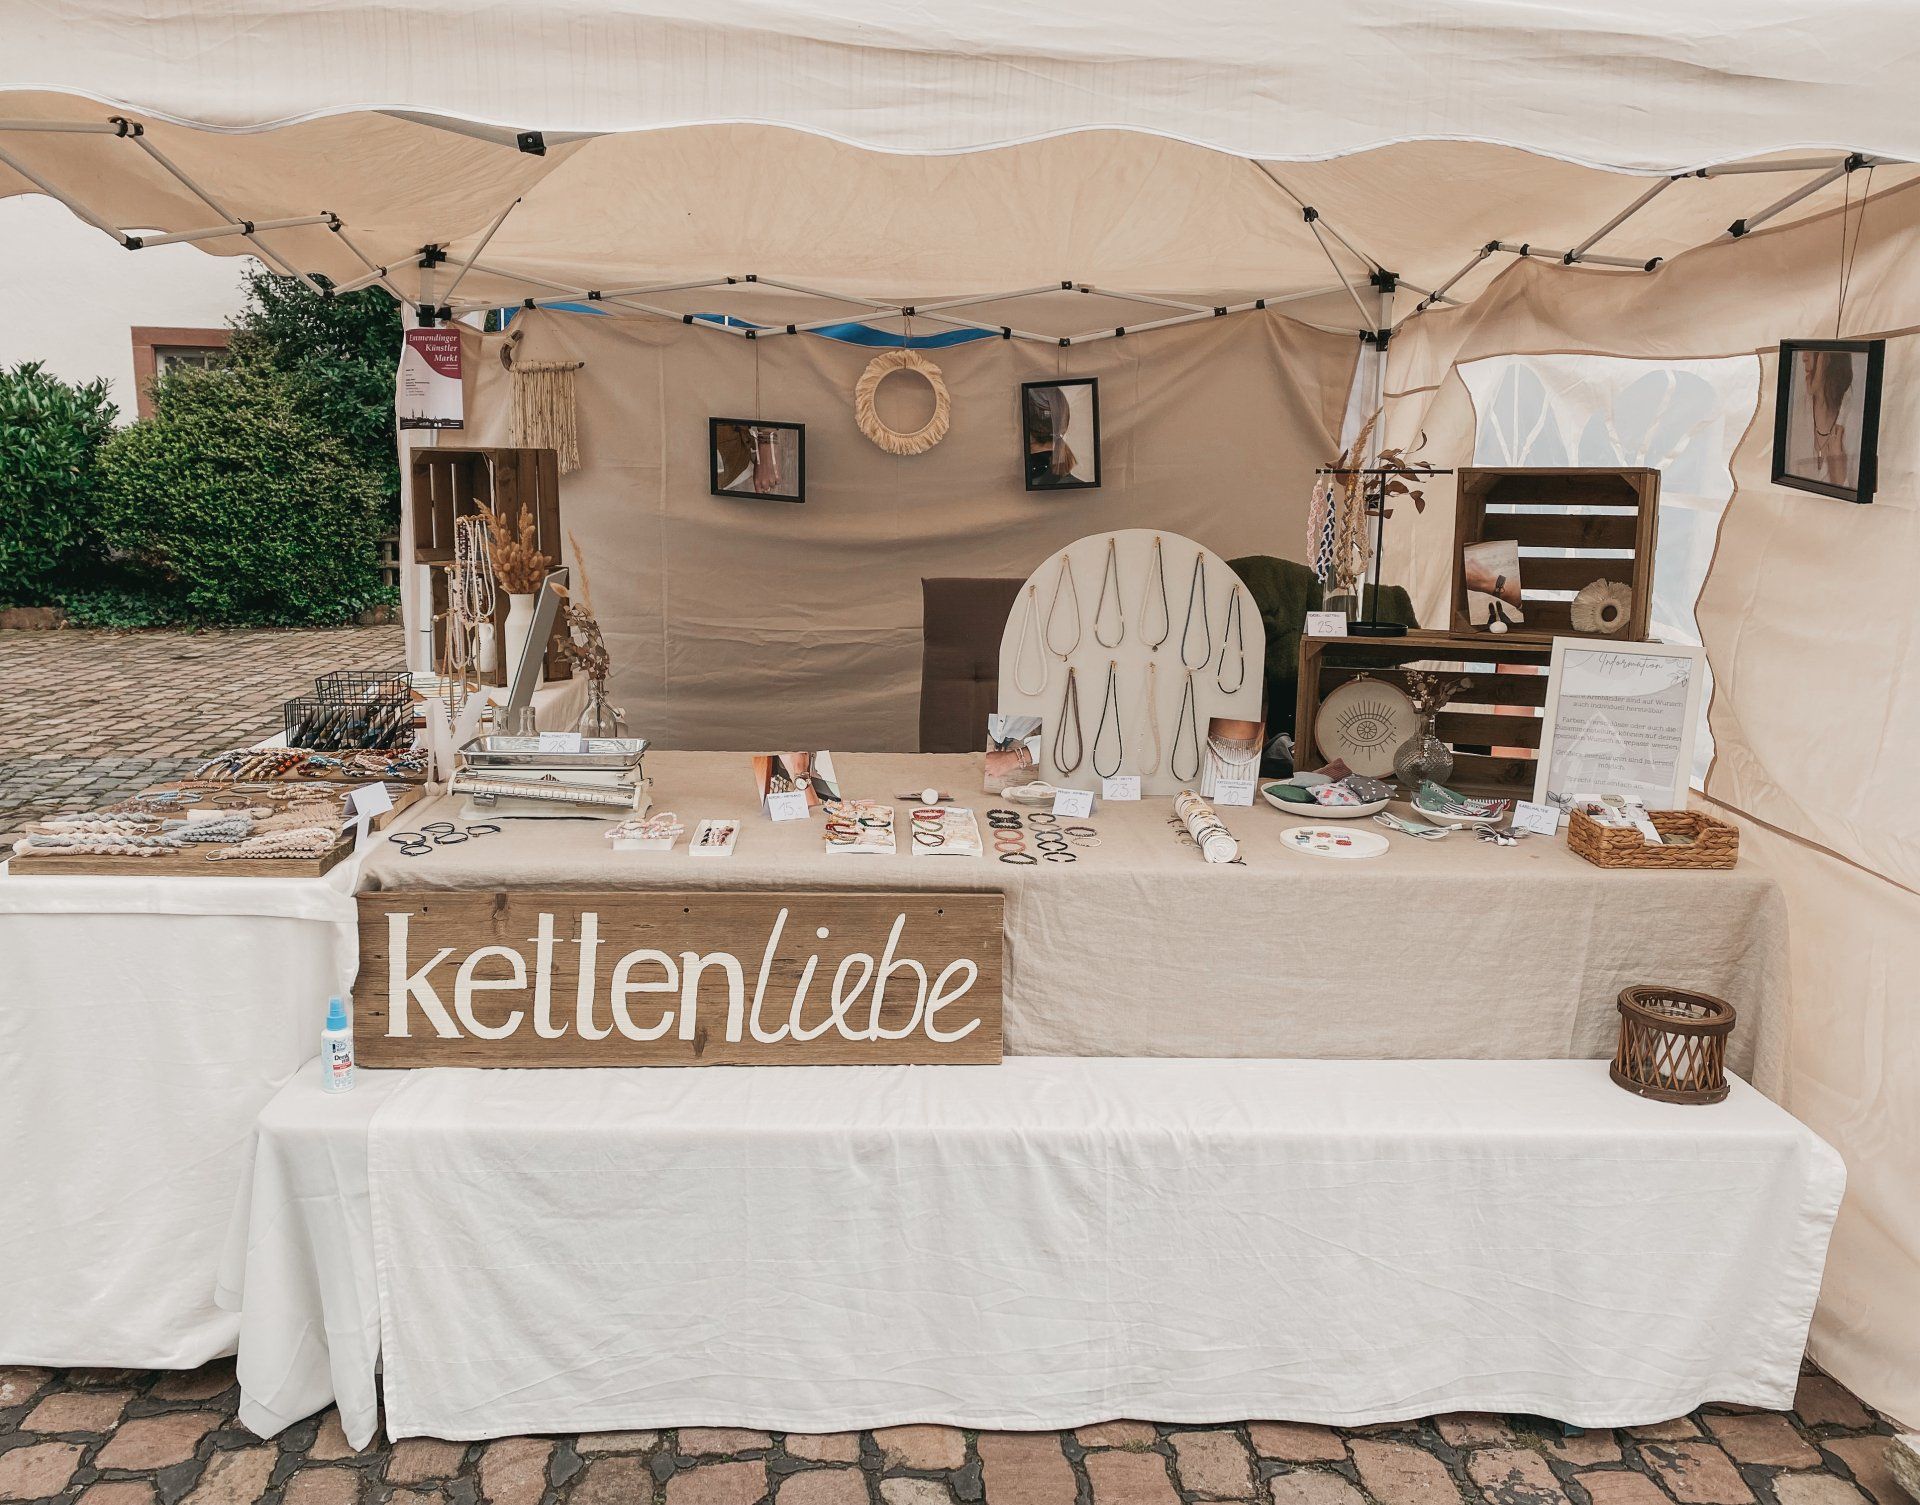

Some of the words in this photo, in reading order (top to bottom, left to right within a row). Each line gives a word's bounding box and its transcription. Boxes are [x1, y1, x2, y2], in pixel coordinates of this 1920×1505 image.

[409, 333, 458, 343] Emmendinger
[425, 343, 458, 352] Künstler
[433, 354, 458, 362] Markt
[1598, 653, 1664, 676] Information
[383, 907, 982, 1044] kettenliebe
